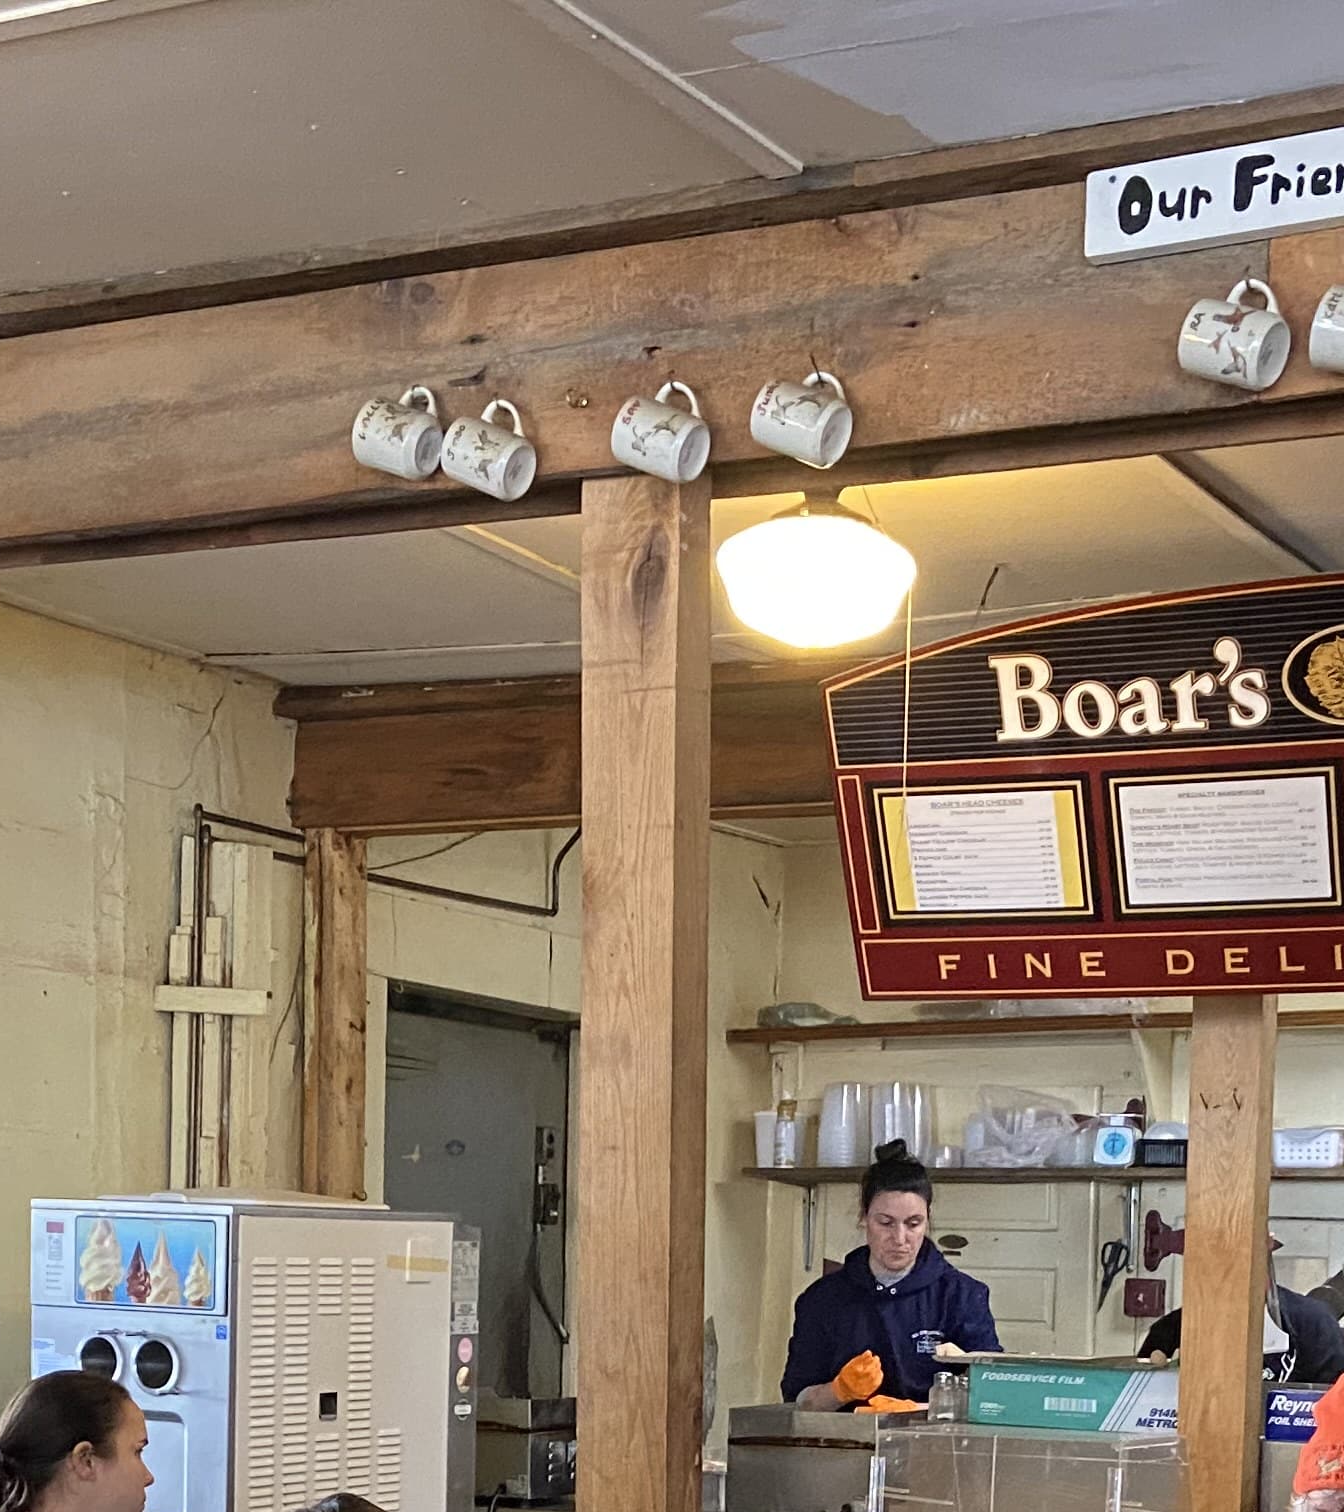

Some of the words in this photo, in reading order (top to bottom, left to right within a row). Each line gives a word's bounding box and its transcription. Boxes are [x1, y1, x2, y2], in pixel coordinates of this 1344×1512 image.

[1117, 174, 1212, 235] Our
[987, 637, 1271, 743] Boar's
[939, 951, 1106, 979] FINE
[981, 1371, 1057, 1385] FOODSERVICE
[1268, 1416, 1290, 1426] FOIL
